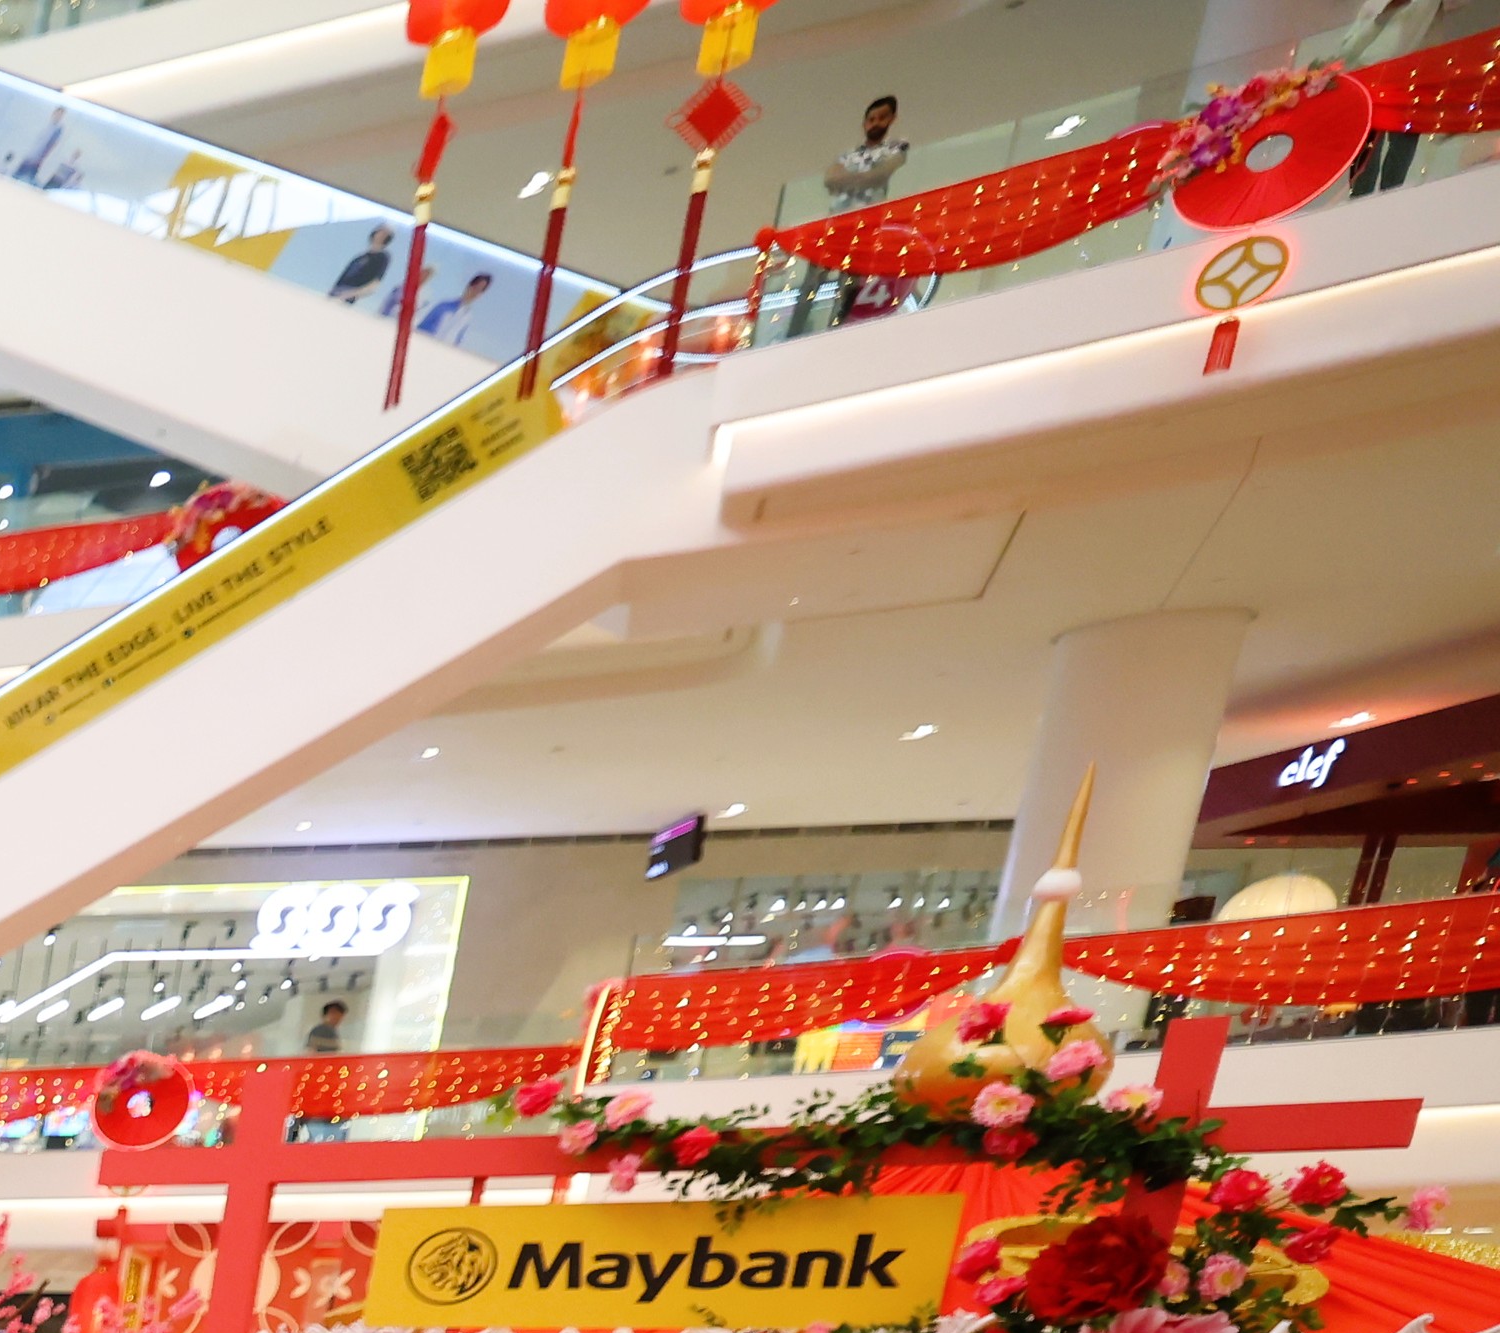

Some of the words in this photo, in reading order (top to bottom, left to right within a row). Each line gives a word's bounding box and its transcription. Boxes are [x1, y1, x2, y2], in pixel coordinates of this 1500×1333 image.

[267, 515, 333, 564] STYLE
[1277, 738, 1347, 790] clef
[506, 1234, 907, 1305] Maybank
